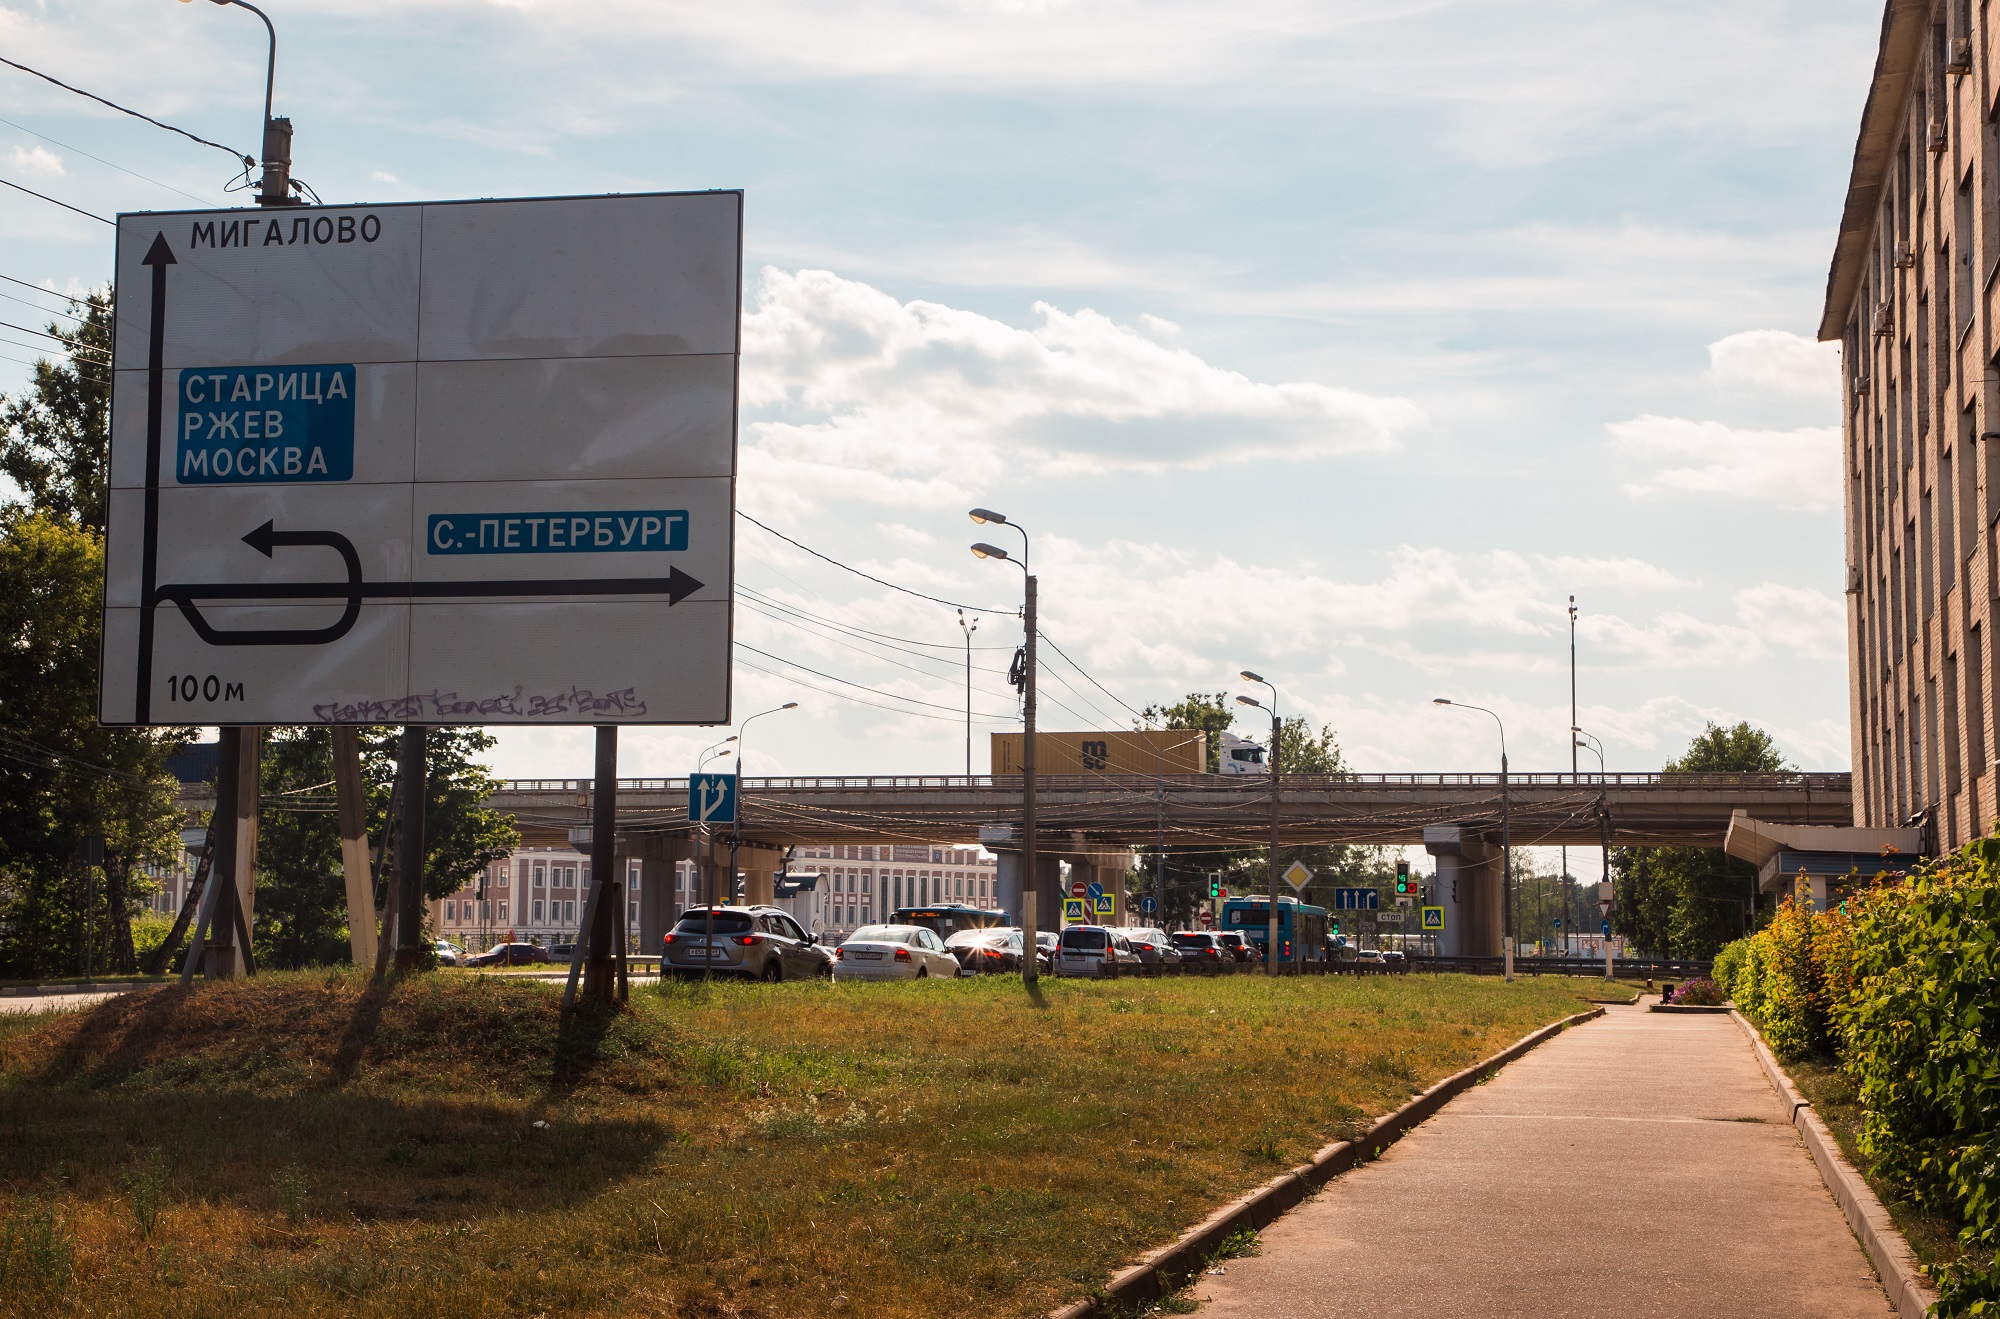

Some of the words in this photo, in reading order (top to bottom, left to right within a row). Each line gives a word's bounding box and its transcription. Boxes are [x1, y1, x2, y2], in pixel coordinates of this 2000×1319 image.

[190, 214, 382, 249] МИГАЛОВО
[185, 371, 348, 405] СТАРИЦА
[184, 410, 284, 440] РЖЕВ
[183, 446, 328, 477] МОСКВА
[433, 516, 683, 549] С.-ПЕТЕРБУРГ
